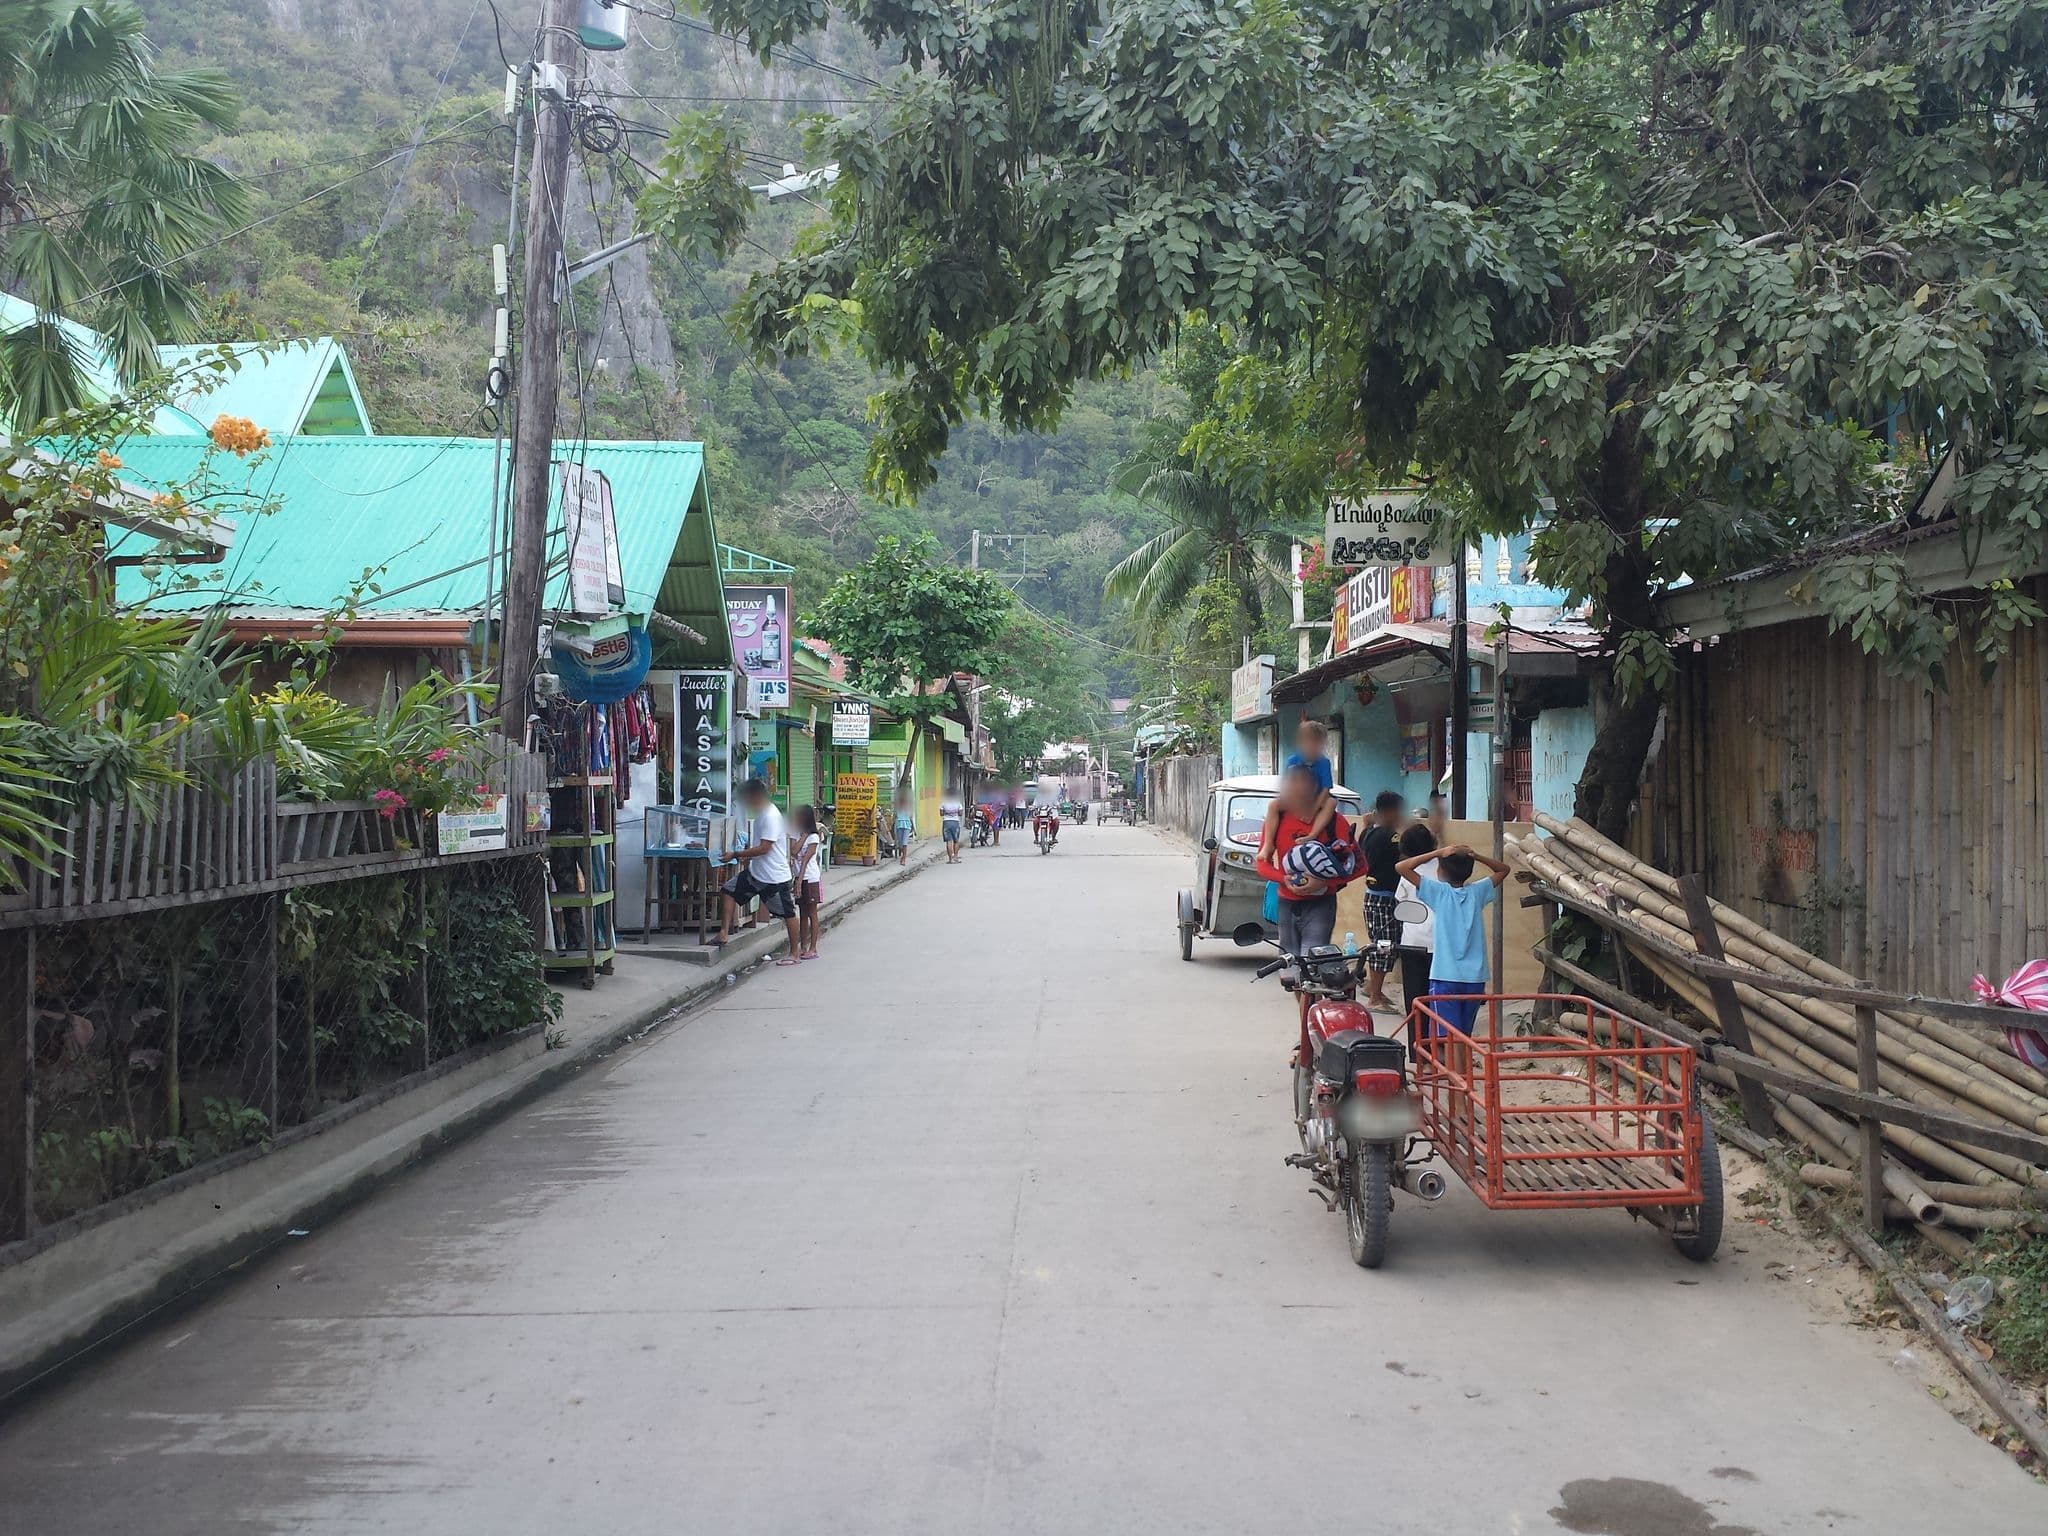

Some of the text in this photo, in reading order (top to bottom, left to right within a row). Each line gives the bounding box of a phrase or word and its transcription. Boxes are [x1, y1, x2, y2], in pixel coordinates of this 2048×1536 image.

[1378, 522, 1388, 533] &
[726, 600, 762, 610] NDUAY
[681, 676, 726, 690] Lucelle's
[834, 702, 869, 715] LYNN'S
[695, 693, 713, 834] MASSAGE
[840, 777, 875, 787] LYNN'S
